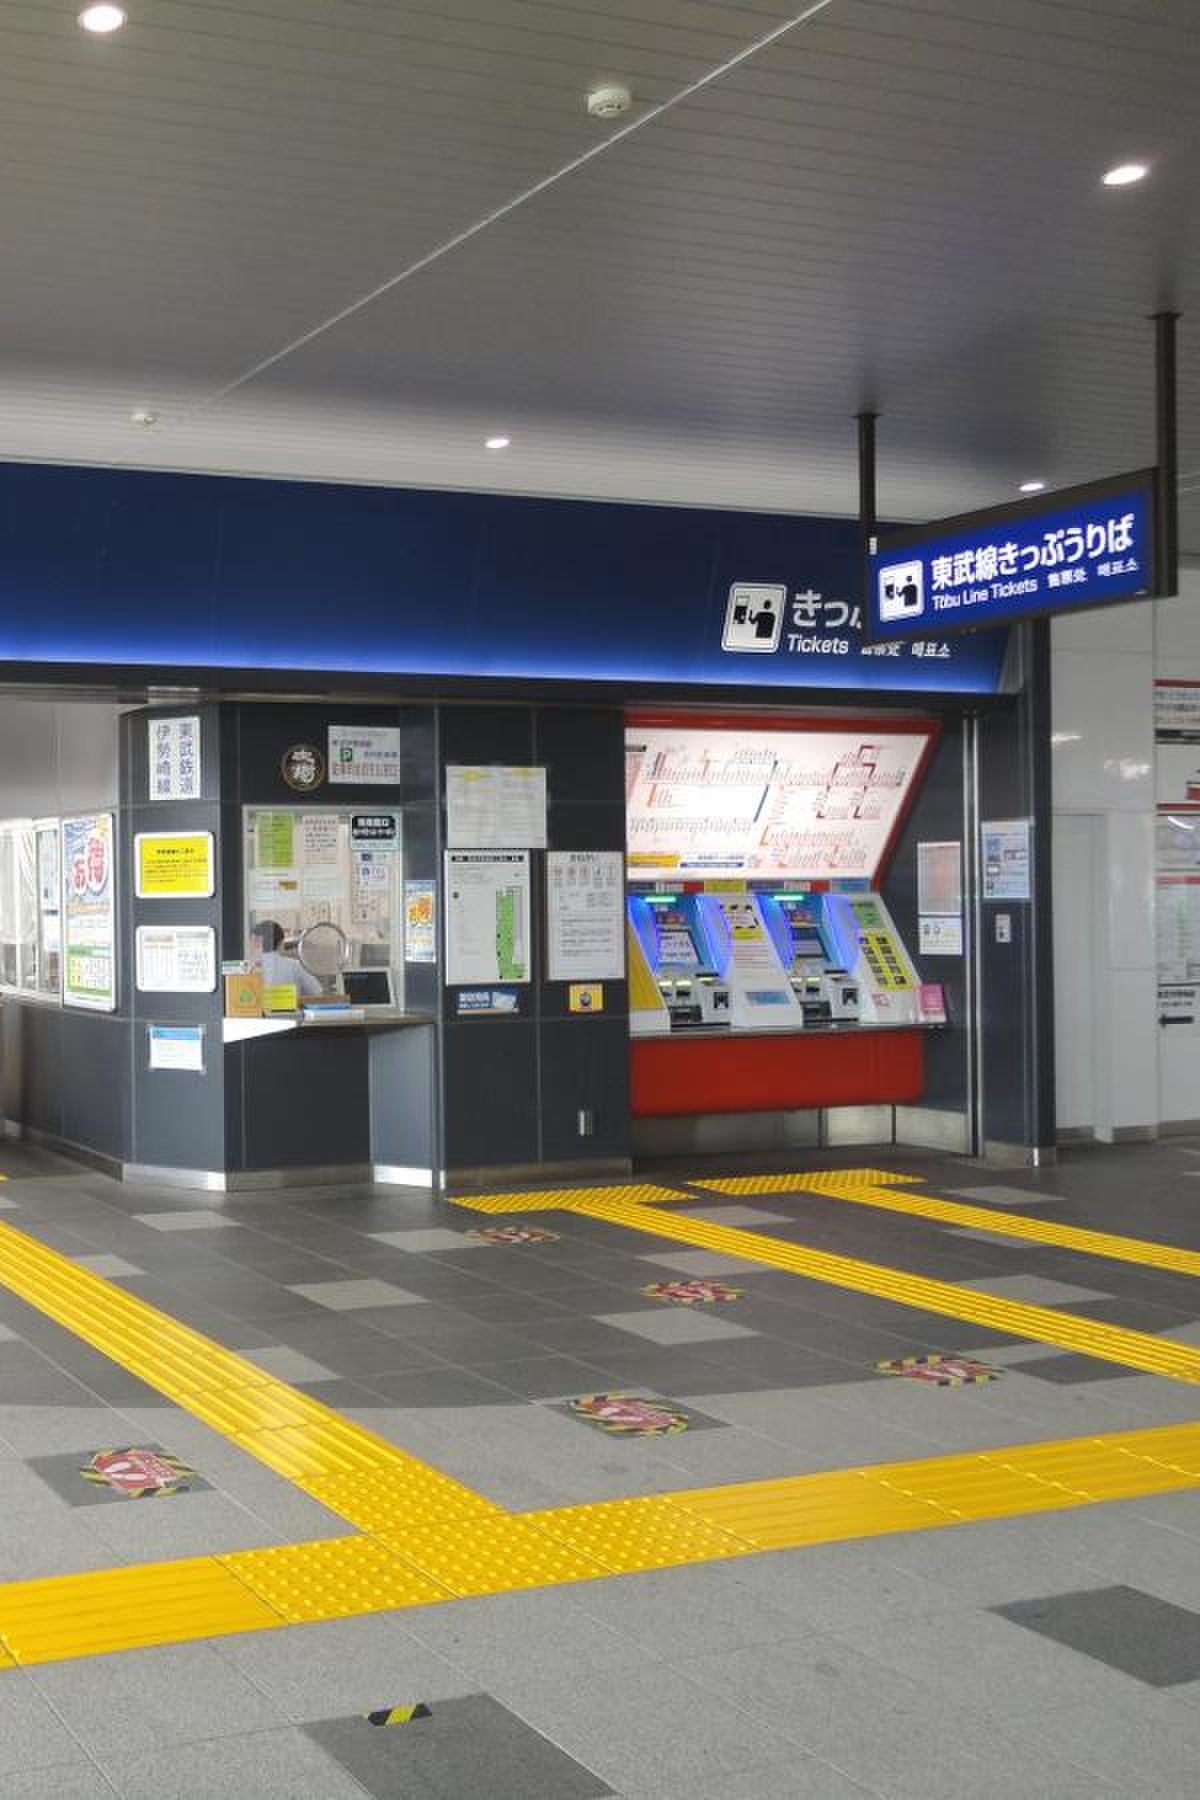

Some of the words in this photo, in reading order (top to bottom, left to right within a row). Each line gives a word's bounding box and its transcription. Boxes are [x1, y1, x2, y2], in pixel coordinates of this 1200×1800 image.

[930, 512, 1136, 591] 東武線きっぷうりば
[963, 587, 989, 608] Line
[989, 578, 1039, 603] Tickets
[786, 633, 850, 656] Tickets
[156, 724, 172, 795] 伊勢崎線
[178, 722, 193, 795] 東武鉄道
